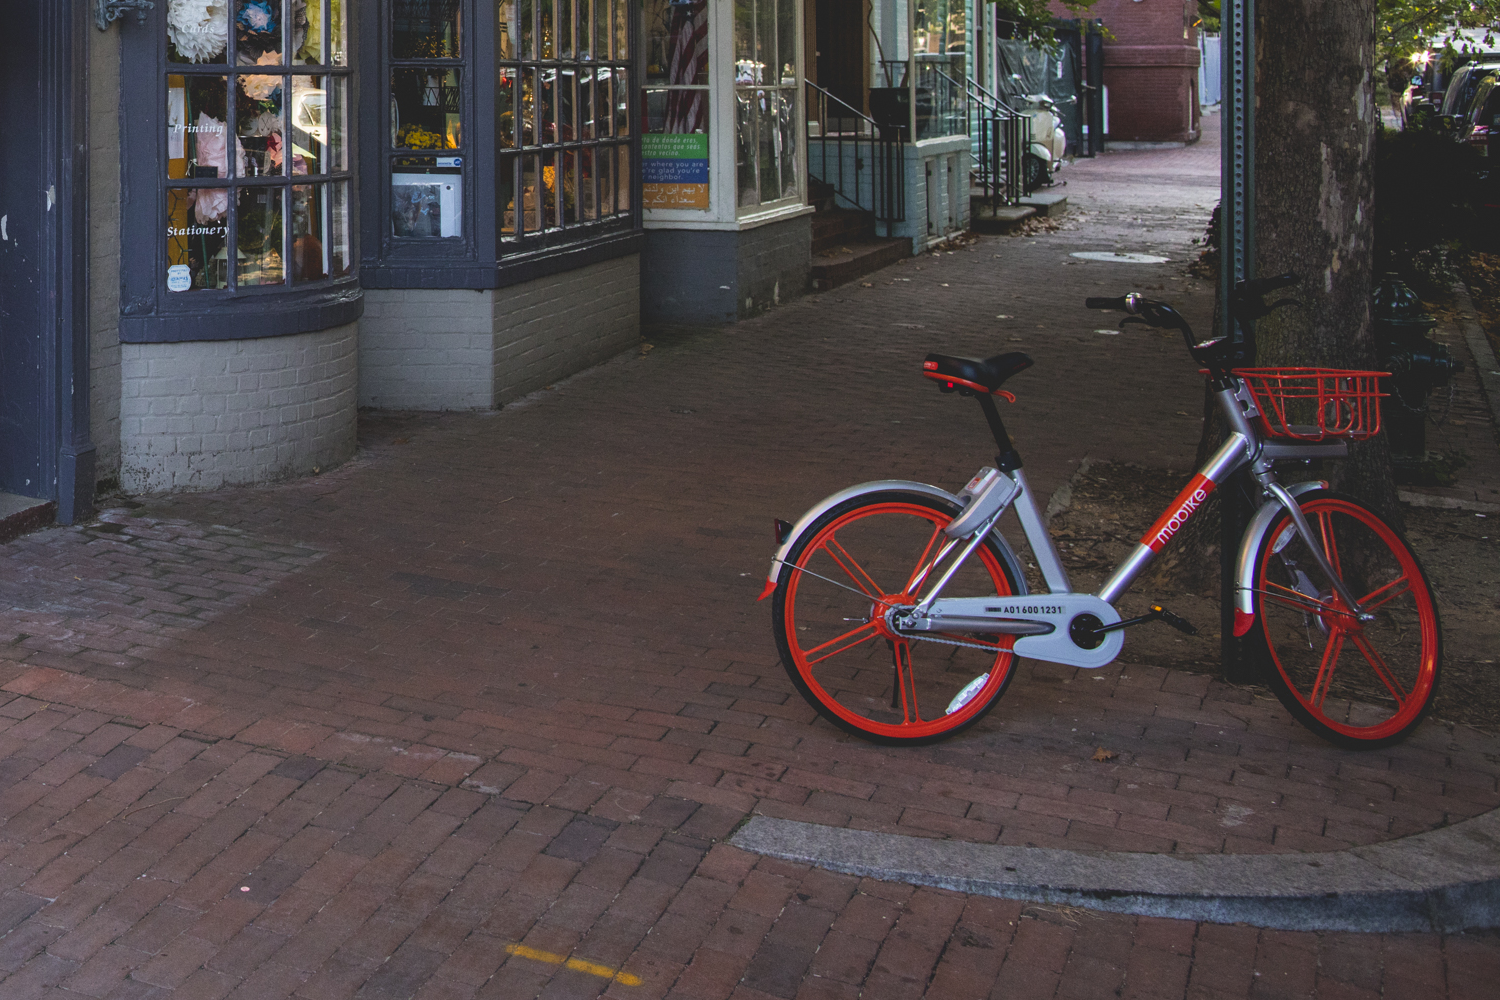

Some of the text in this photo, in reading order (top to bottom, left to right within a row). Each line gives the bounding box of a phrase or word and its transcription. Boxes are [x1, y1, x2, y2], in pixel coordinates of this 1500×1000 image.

[181, 23, 215, 34] Cards
[173, 123, 223, 137] Printing
[658, 167, 675, 175] glad
[677, 167, 700, 175] you're
[167, 224, 229, 239] Stationery
[1157, 489, 1207, 545] mobike
